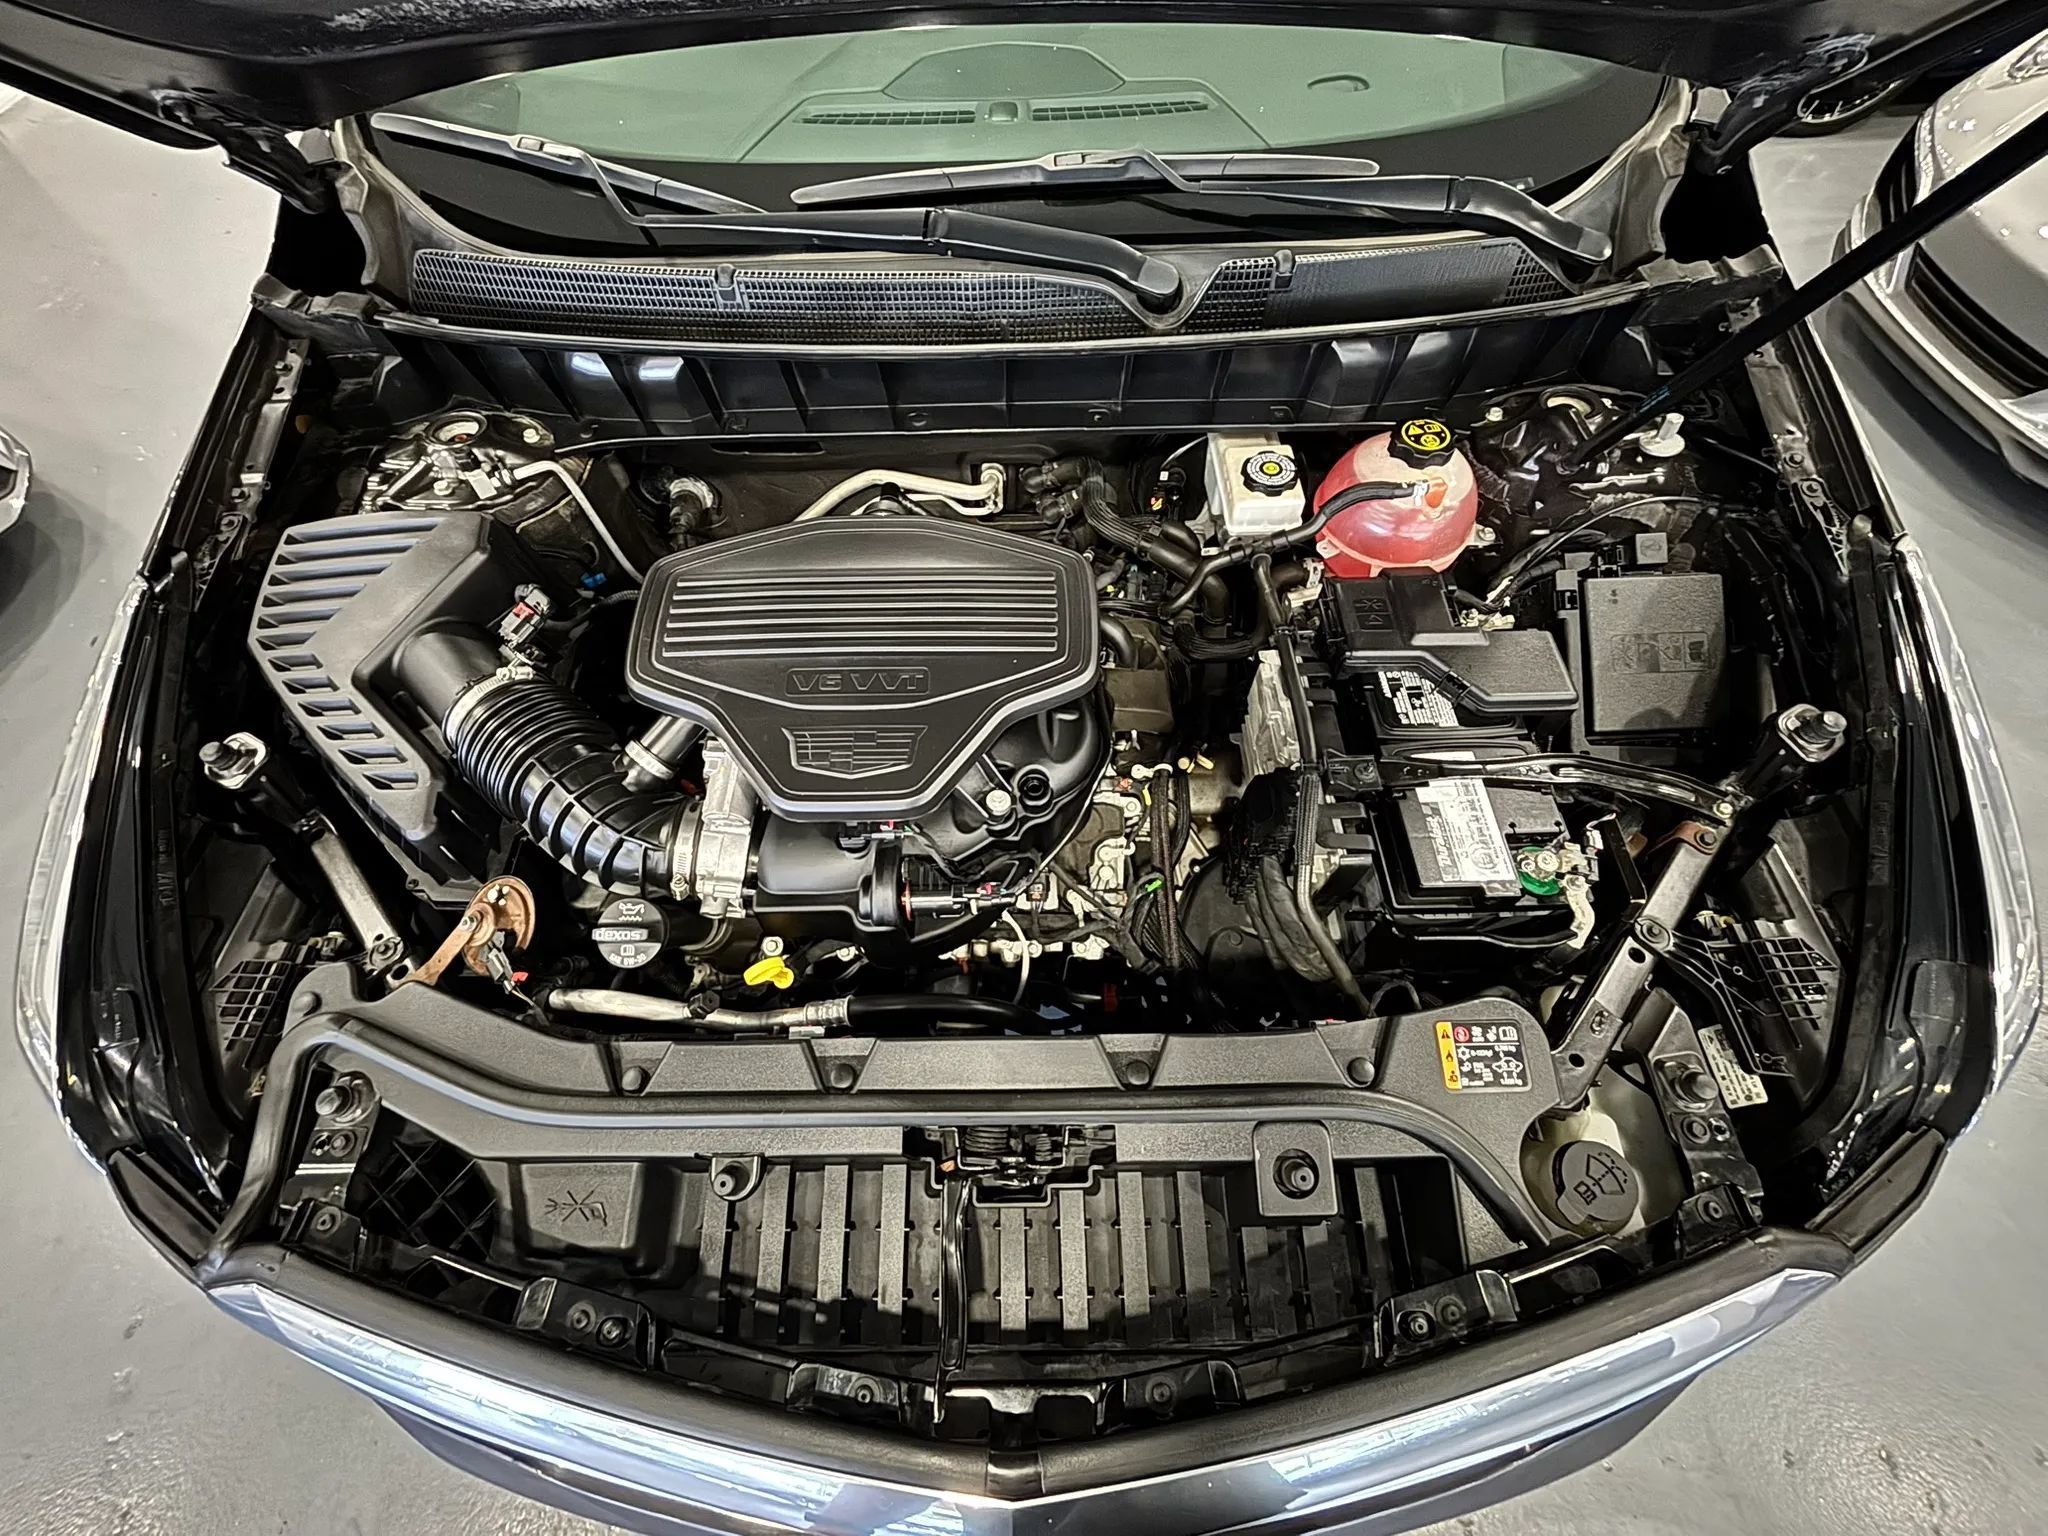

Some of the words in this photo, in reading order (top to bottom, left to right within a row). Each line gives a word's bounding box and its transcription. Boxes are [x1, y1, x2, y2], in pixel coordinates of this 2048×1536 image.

[792, 673, 842, 691] V6
[850, 672, 924, 691] VVT
[595, 927, 641, 941] dexos
